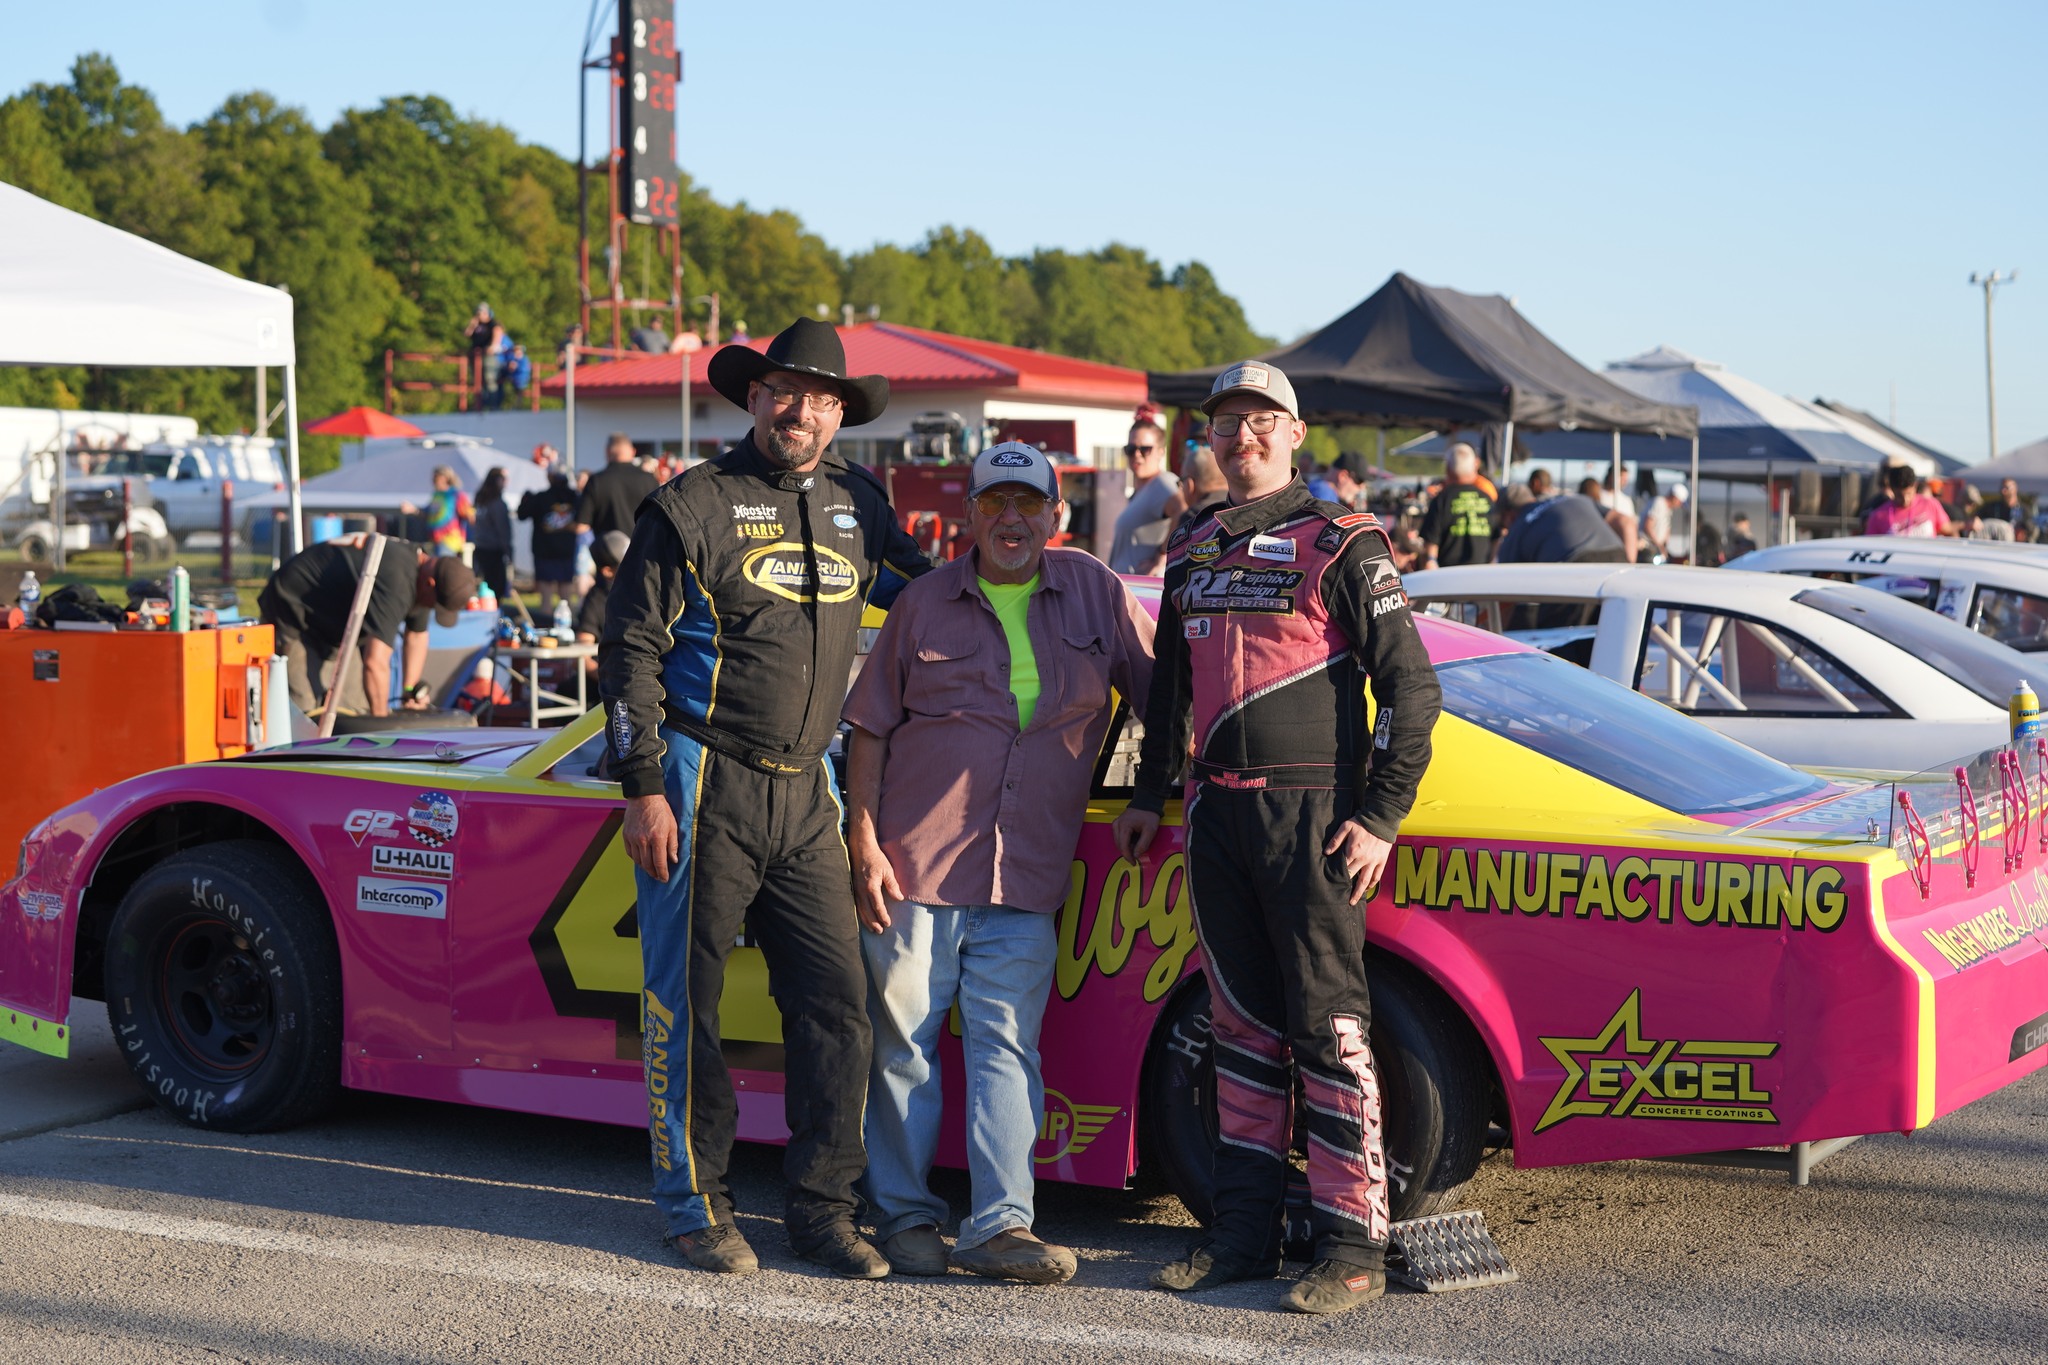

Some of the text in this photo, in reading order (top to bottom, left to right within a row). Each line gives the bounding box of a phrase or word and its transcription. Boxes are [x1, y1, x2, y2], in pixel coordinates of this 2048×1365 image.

[633, 18, 647, 48] 2
[634, 126, 648, 155] 4
[998, 453, 1025, 465] Ford
[732, 503, 777, 520] Hoosier
[745, 524, 785, 537] EARL'S
[1847, 551, 1893, 564] RJ
[1229, 583, 1278, 598] Design
[1373, 592, 1405, 618] ARCA
[344, 809, 397, 833] GP
[375, 849, 452, 870] U-HAUL
[361, 886, 434, 910] Intercomp
[1393, 845, 1849, 932] MANUFACTURING
[190, 876, 284, 979] Hoosier
[644, 988, 676, 1172] LANDRUM
[1588, 1044, 1773, 1114] EXCEL
[1639, 1106, 1764, 1119] CONCRETE COATINGS
[1333, 1016, 1389, 1242] TACKMAN
